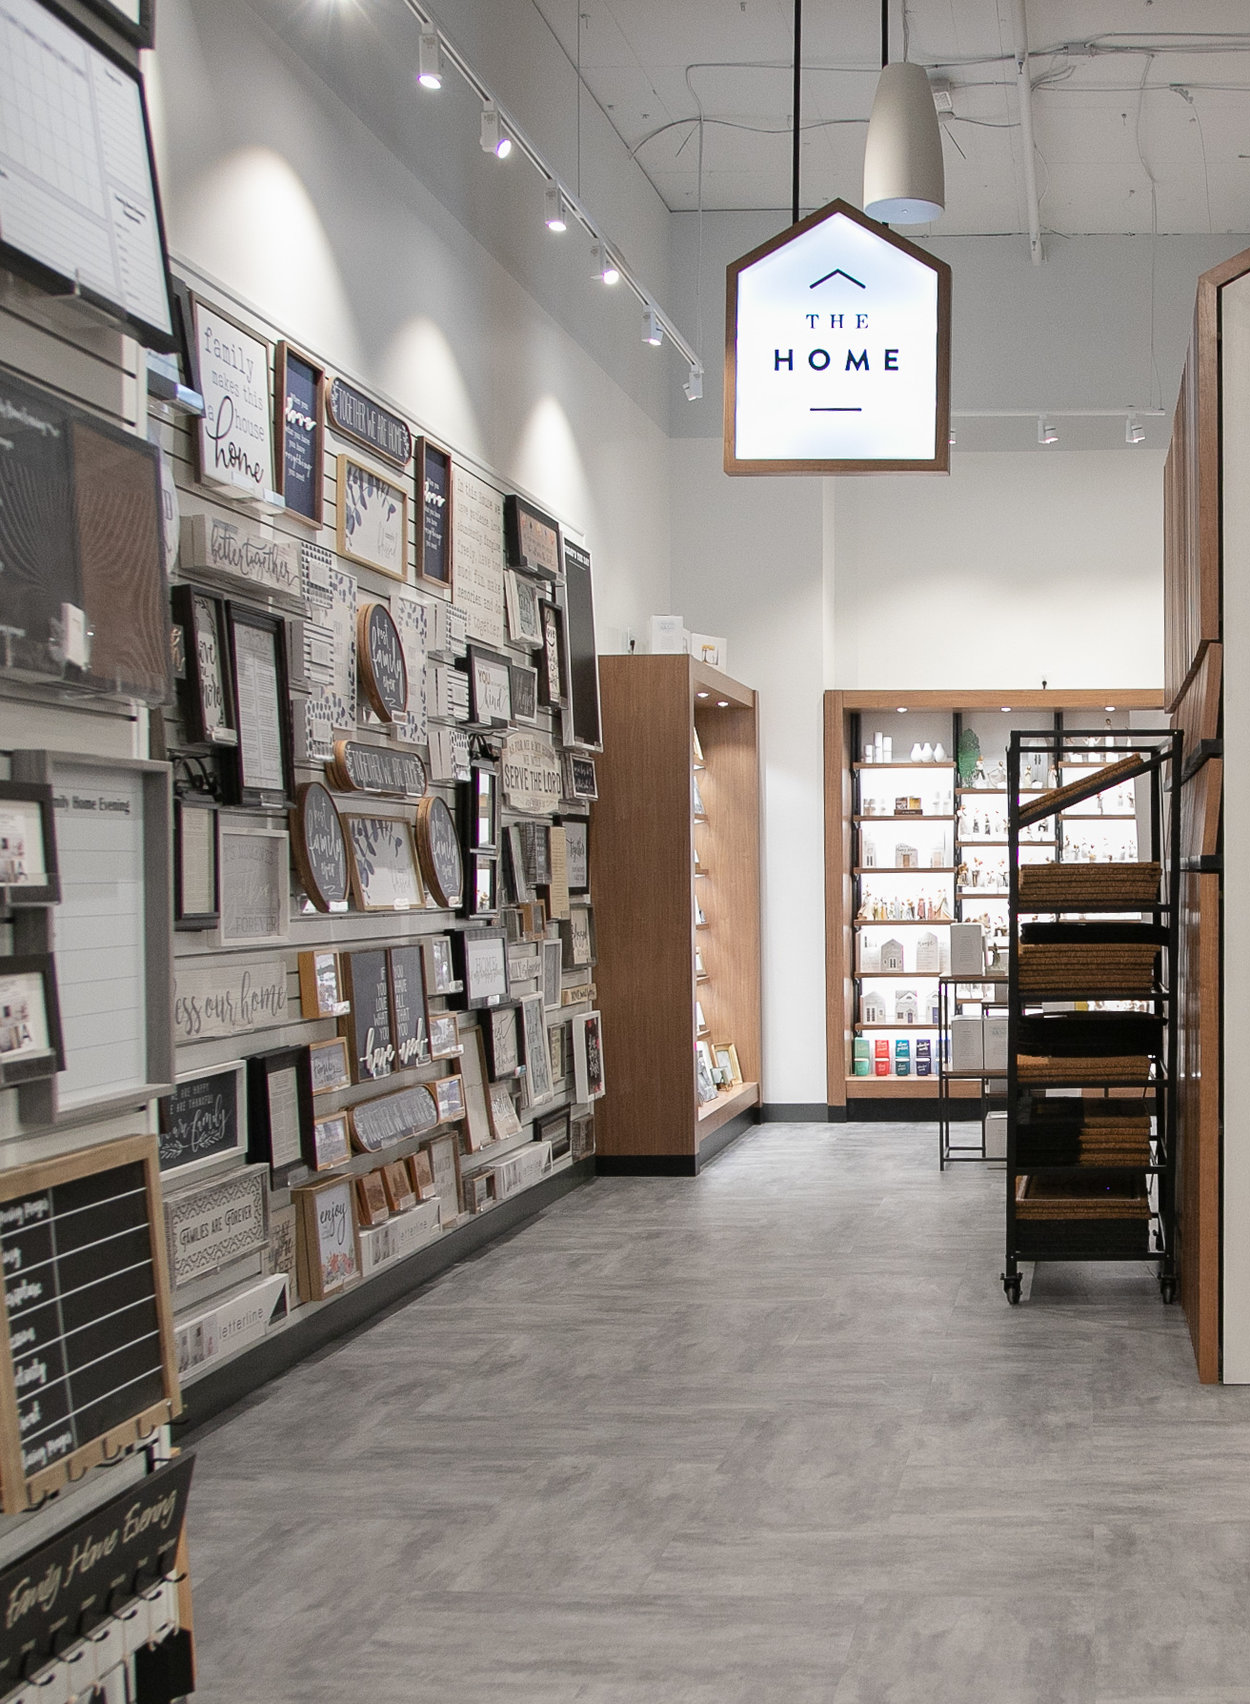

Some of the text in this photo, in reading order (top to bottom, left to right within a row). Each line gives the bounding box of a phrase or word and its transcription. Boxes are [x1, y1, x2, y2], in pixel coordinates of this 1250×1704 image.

[805, 313, 869, 329] THE
[204, 326, 254, 384] family
[773, 348, 899, 372] HOME
[212, 369, 263, 411] makes this
[205, 395, 264, 484] home
[207, 404, 264, 442] a house
[211, 523, 301, 587] better together
[504, 763, 528, 790] SERVE
[529, 769, 542, 791] THE
[542, 769, 561, 794] LORD
[72, 795, 97, 811] Home
[99, 796, 131, 815] Evening
[175, 970, 286, 1035] ess our home
[189, 1094, 233, 1153] family
[179, 1204, 252, 1252] FAMILIES ARE FOREVER
[320, 1200, 347, 1245] enjoy
[218, 1306, 264, 1340] letterline
[5, 1563, 62, 1631] Family
[63, 1528, 119, 1588] Home
[122, 1489, 178, 1545] Evening
